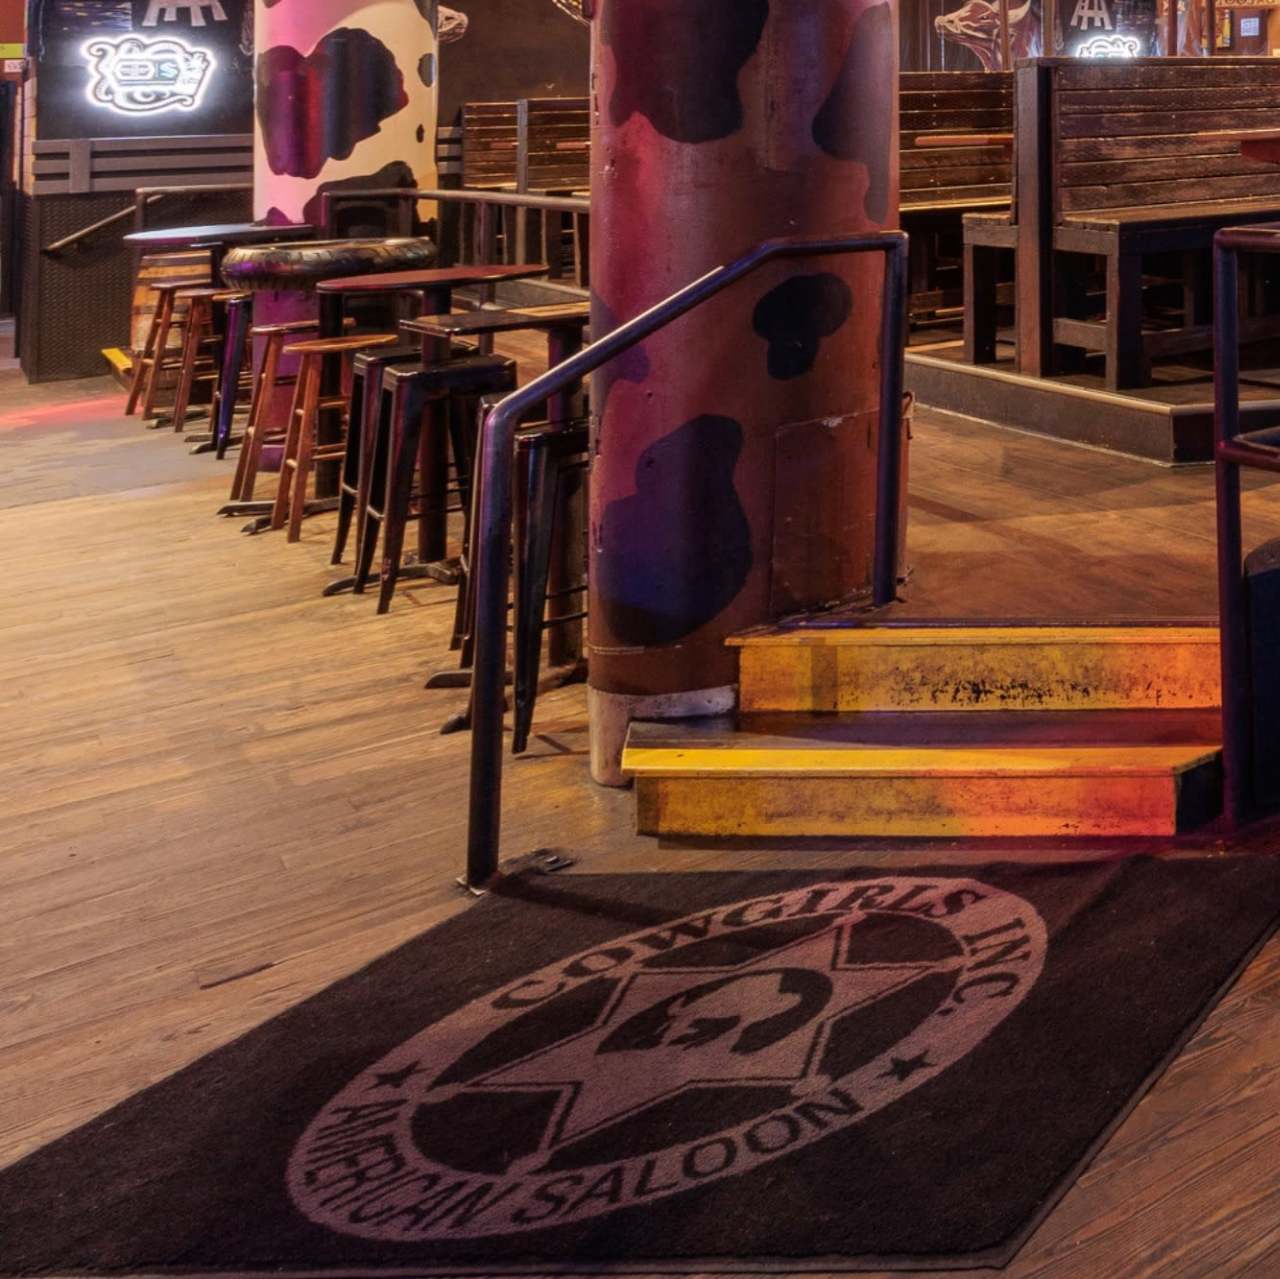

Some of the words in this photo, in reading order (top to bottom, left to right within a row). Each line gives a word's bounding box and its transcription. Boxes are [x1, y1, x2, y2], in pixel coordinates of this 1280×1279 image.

[489, 880, 990, 1013] COWGIRLS
[938, 915, 1033, 1018] INC.
[304, 1101, 518, 1235] AMERICAN
[510, 1086, 865, 1228] SALOON
